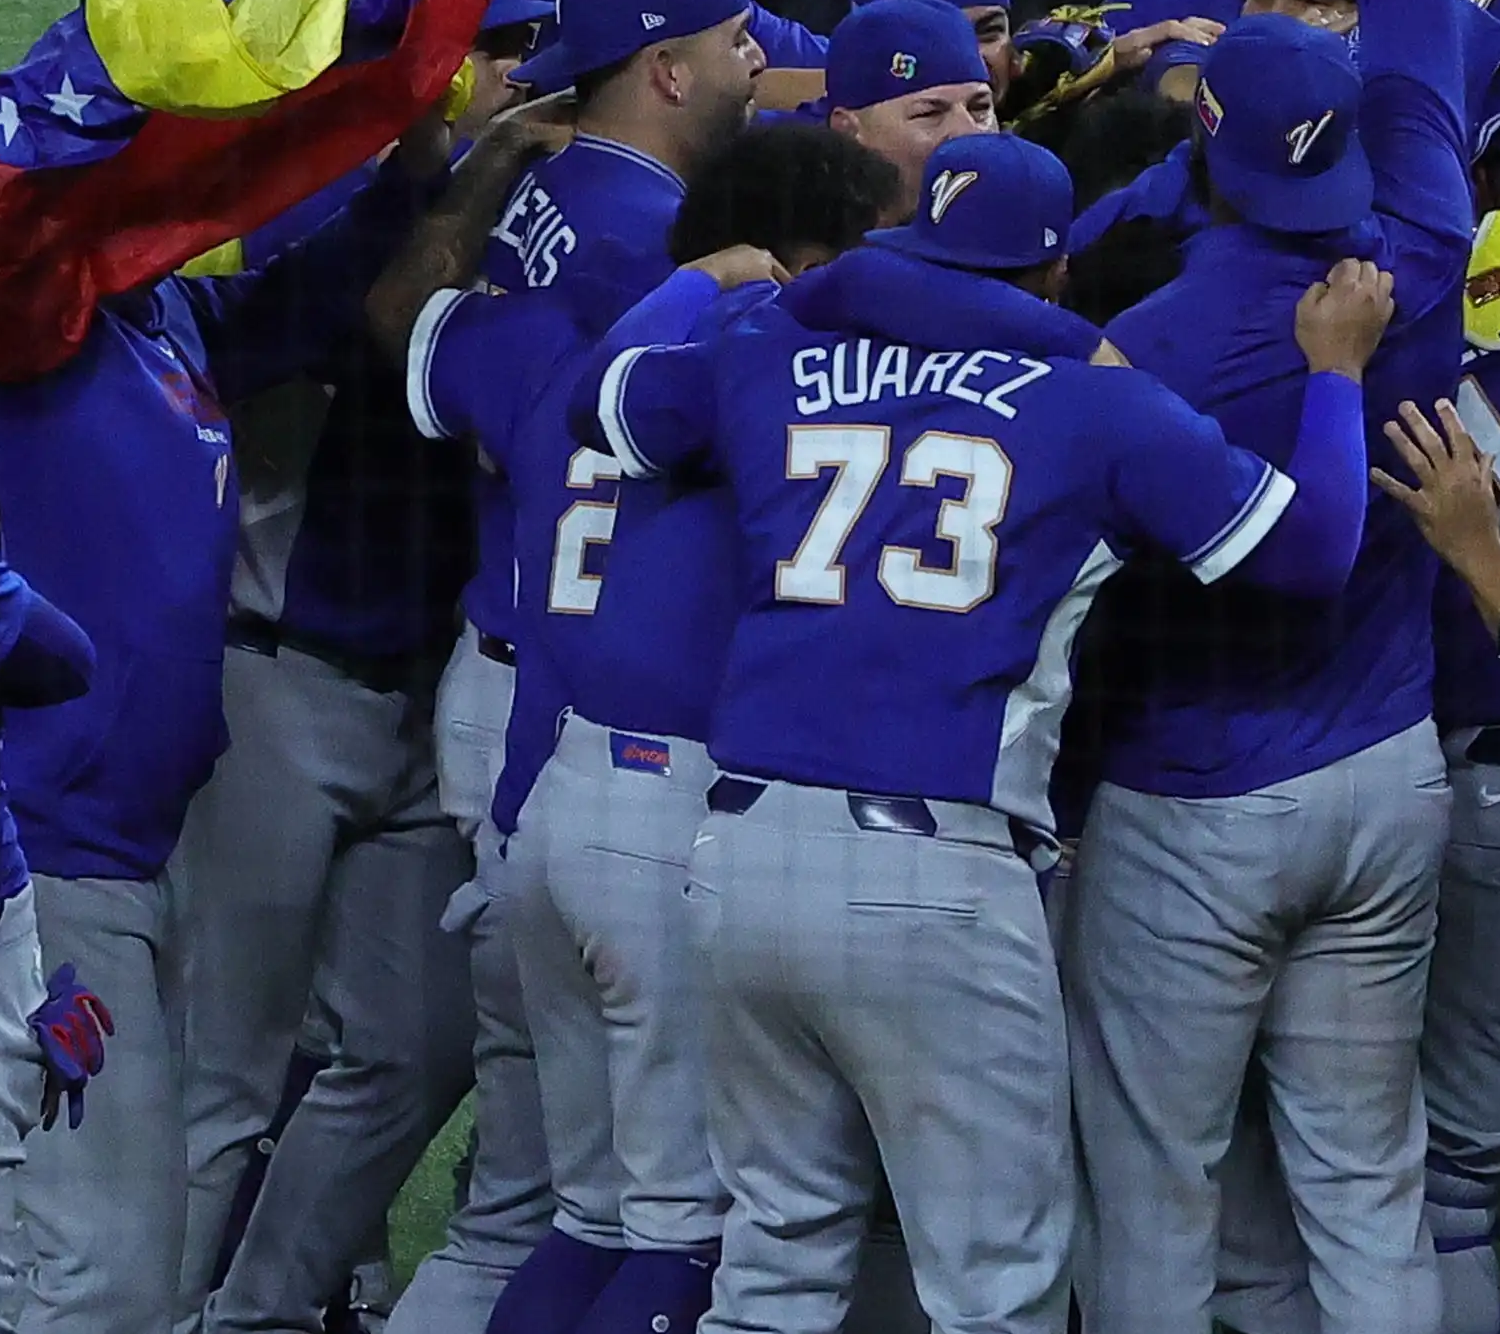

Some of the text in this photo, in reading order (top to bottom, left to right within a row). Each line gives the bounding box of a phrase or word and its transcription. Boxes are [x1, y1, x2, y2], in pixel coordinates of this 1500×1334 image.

[1286, 109, 1334, 165] V
[931, 169, 978, 224] V
[792, 338, 1053, 420] SUAREZ
[775, 423, 1013, 614] 73
